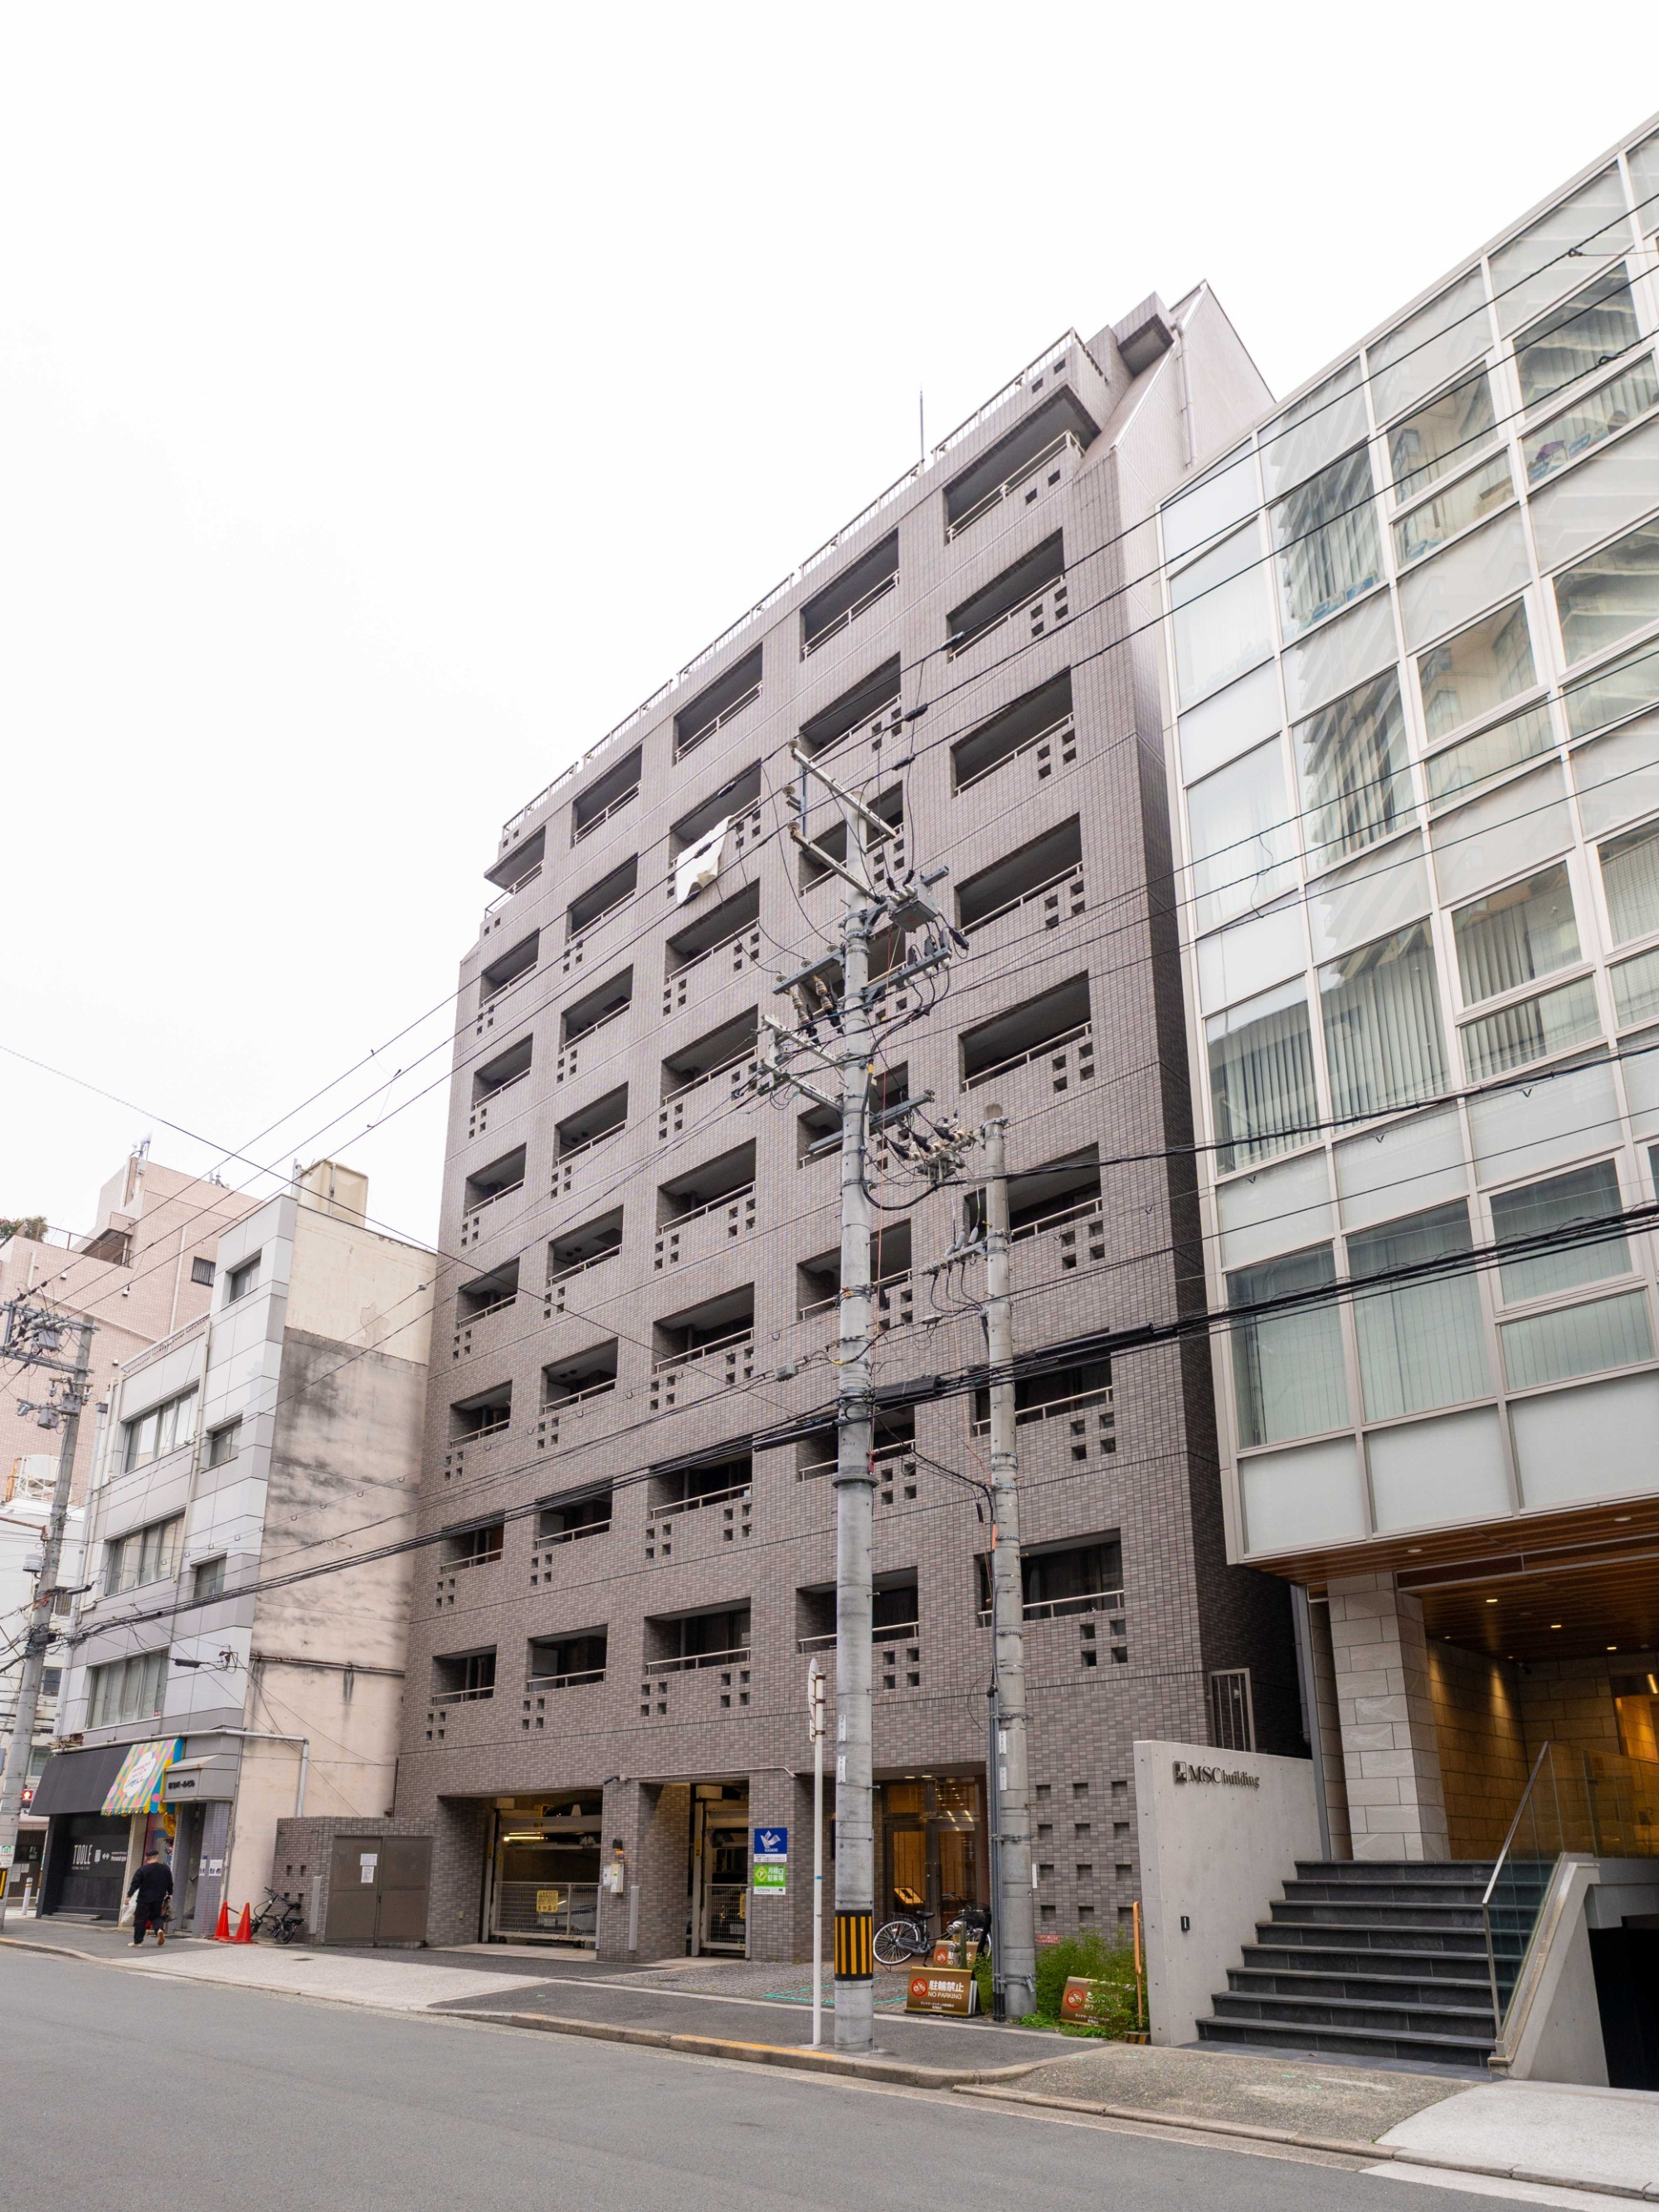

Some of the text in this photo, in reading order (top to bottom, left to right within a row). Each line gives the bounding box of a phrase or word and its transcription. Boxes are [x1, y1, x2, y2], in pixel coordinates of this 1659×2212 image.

[1187, 1764, 1260, 1789] MSC building
[73, 1845, 92, 1864] TOOLE
[929, 1981, 964, 1992] 駐輪禁止
[937, 1991, 962, 2000] PARKING
